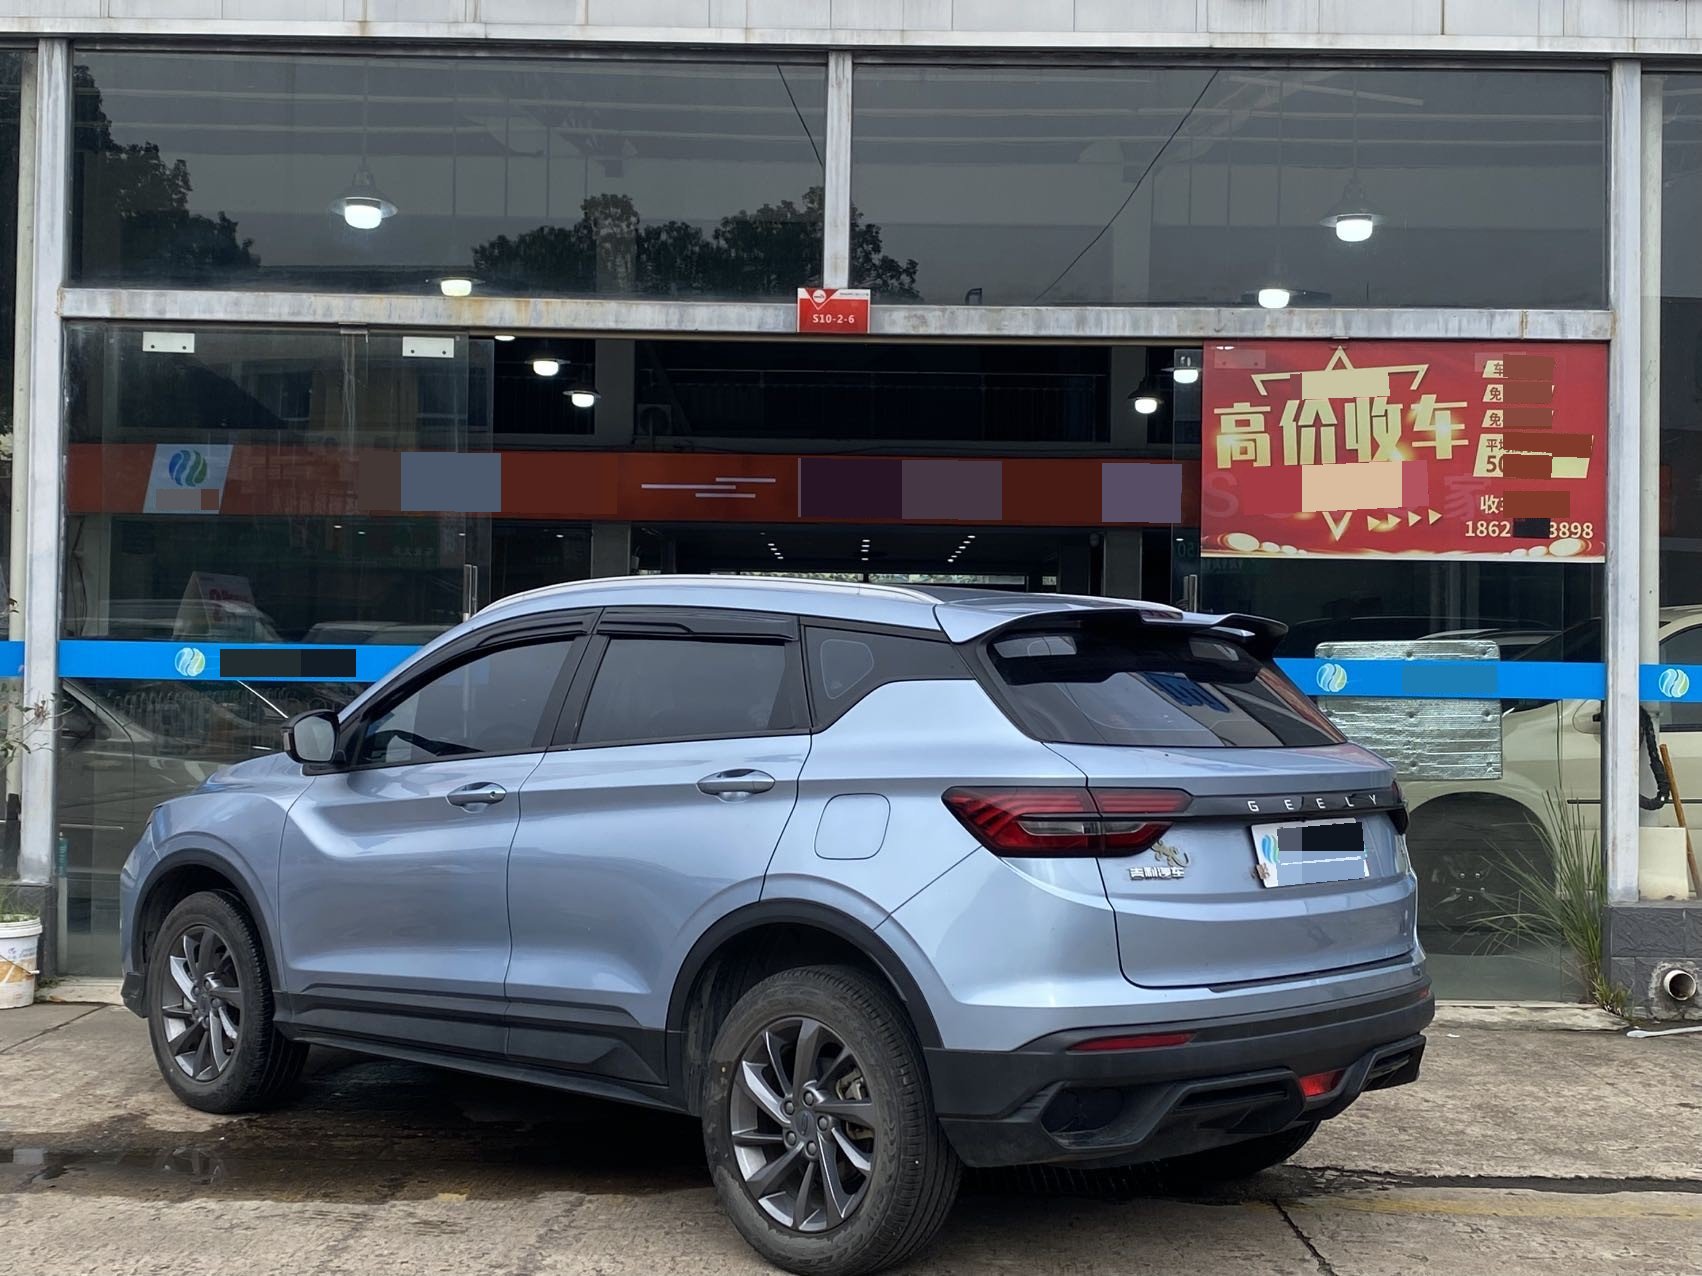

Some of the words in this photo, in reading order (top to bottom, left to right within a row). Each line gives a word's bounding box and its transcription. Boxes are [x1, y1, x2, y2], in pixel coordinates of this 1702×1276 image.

[812, 314, 855, 324] S10-2-6
[1213, 393, 1470, 469] 高价收车
[1246, 793, 1378, 813] GEELY
